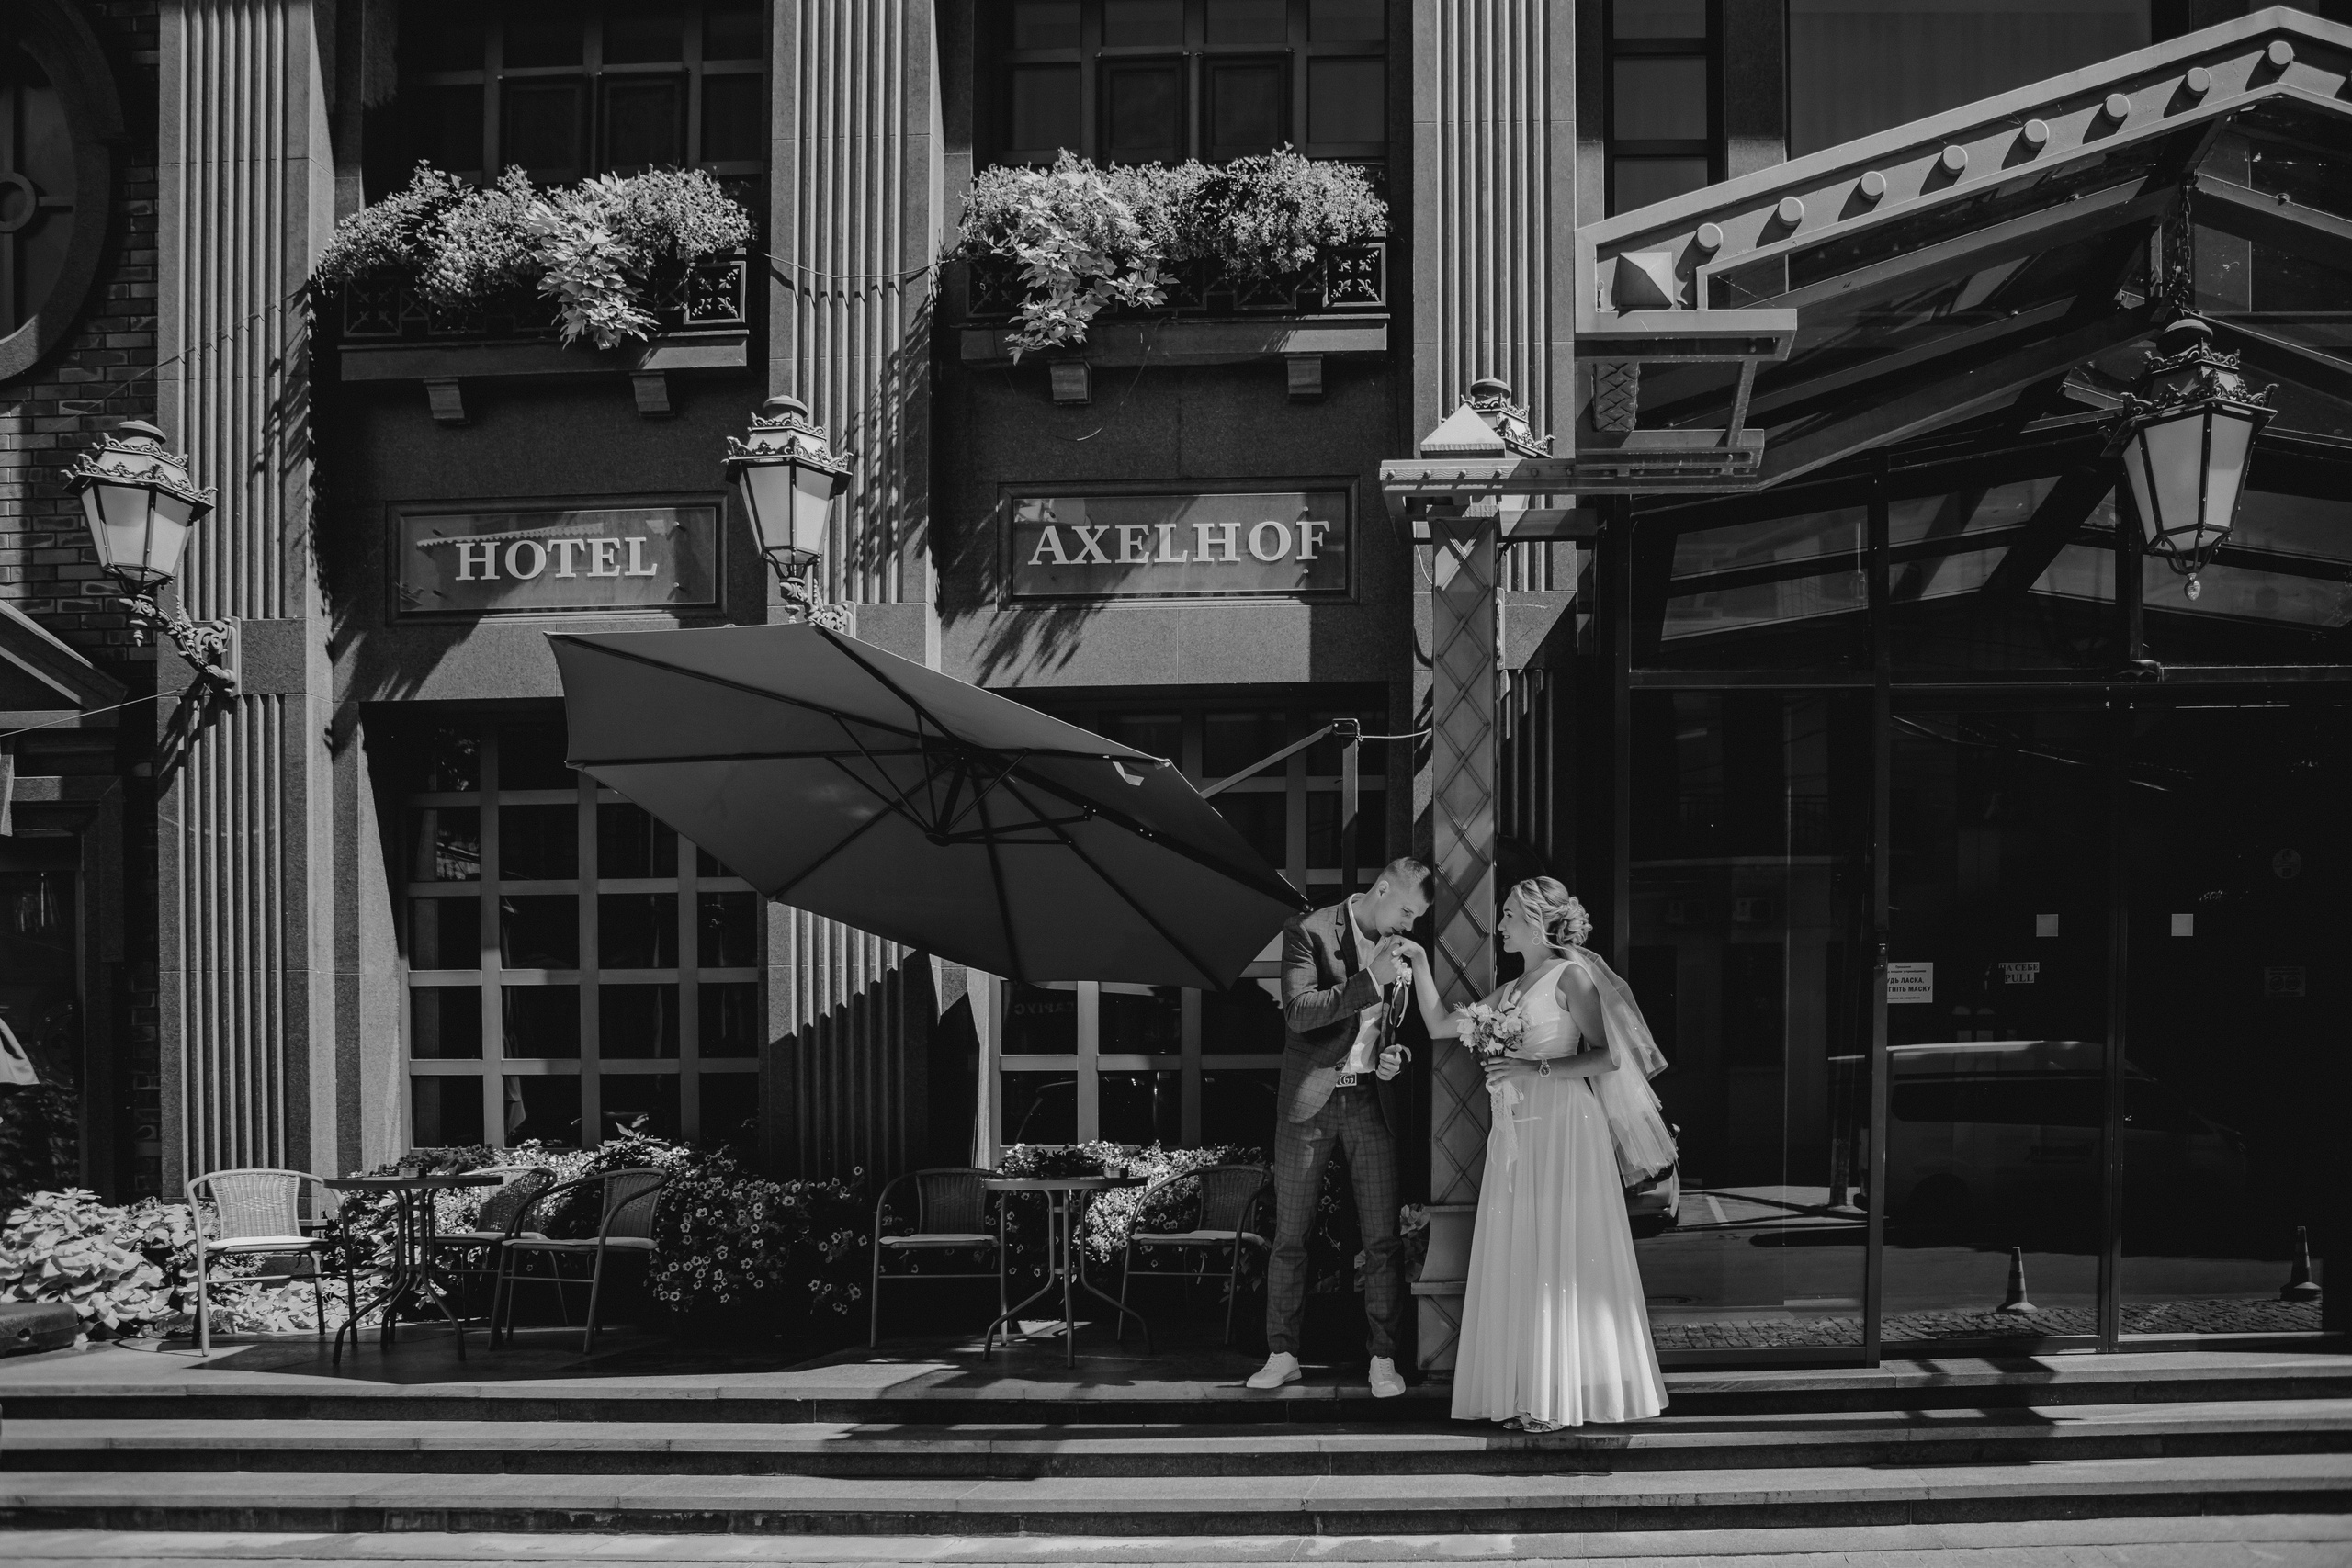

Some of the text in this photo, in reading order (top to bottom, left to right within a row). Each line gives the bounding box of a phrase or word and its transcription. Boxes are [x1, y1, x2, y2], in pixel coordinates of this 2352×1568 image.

[1027, 520, 1330, 566] AXELHOF
[455, 536, 658, 581] HOTEL
[2005, 974, 2034, 983] PULL
[2015, 964, 2039, 972] СЕБЕ
